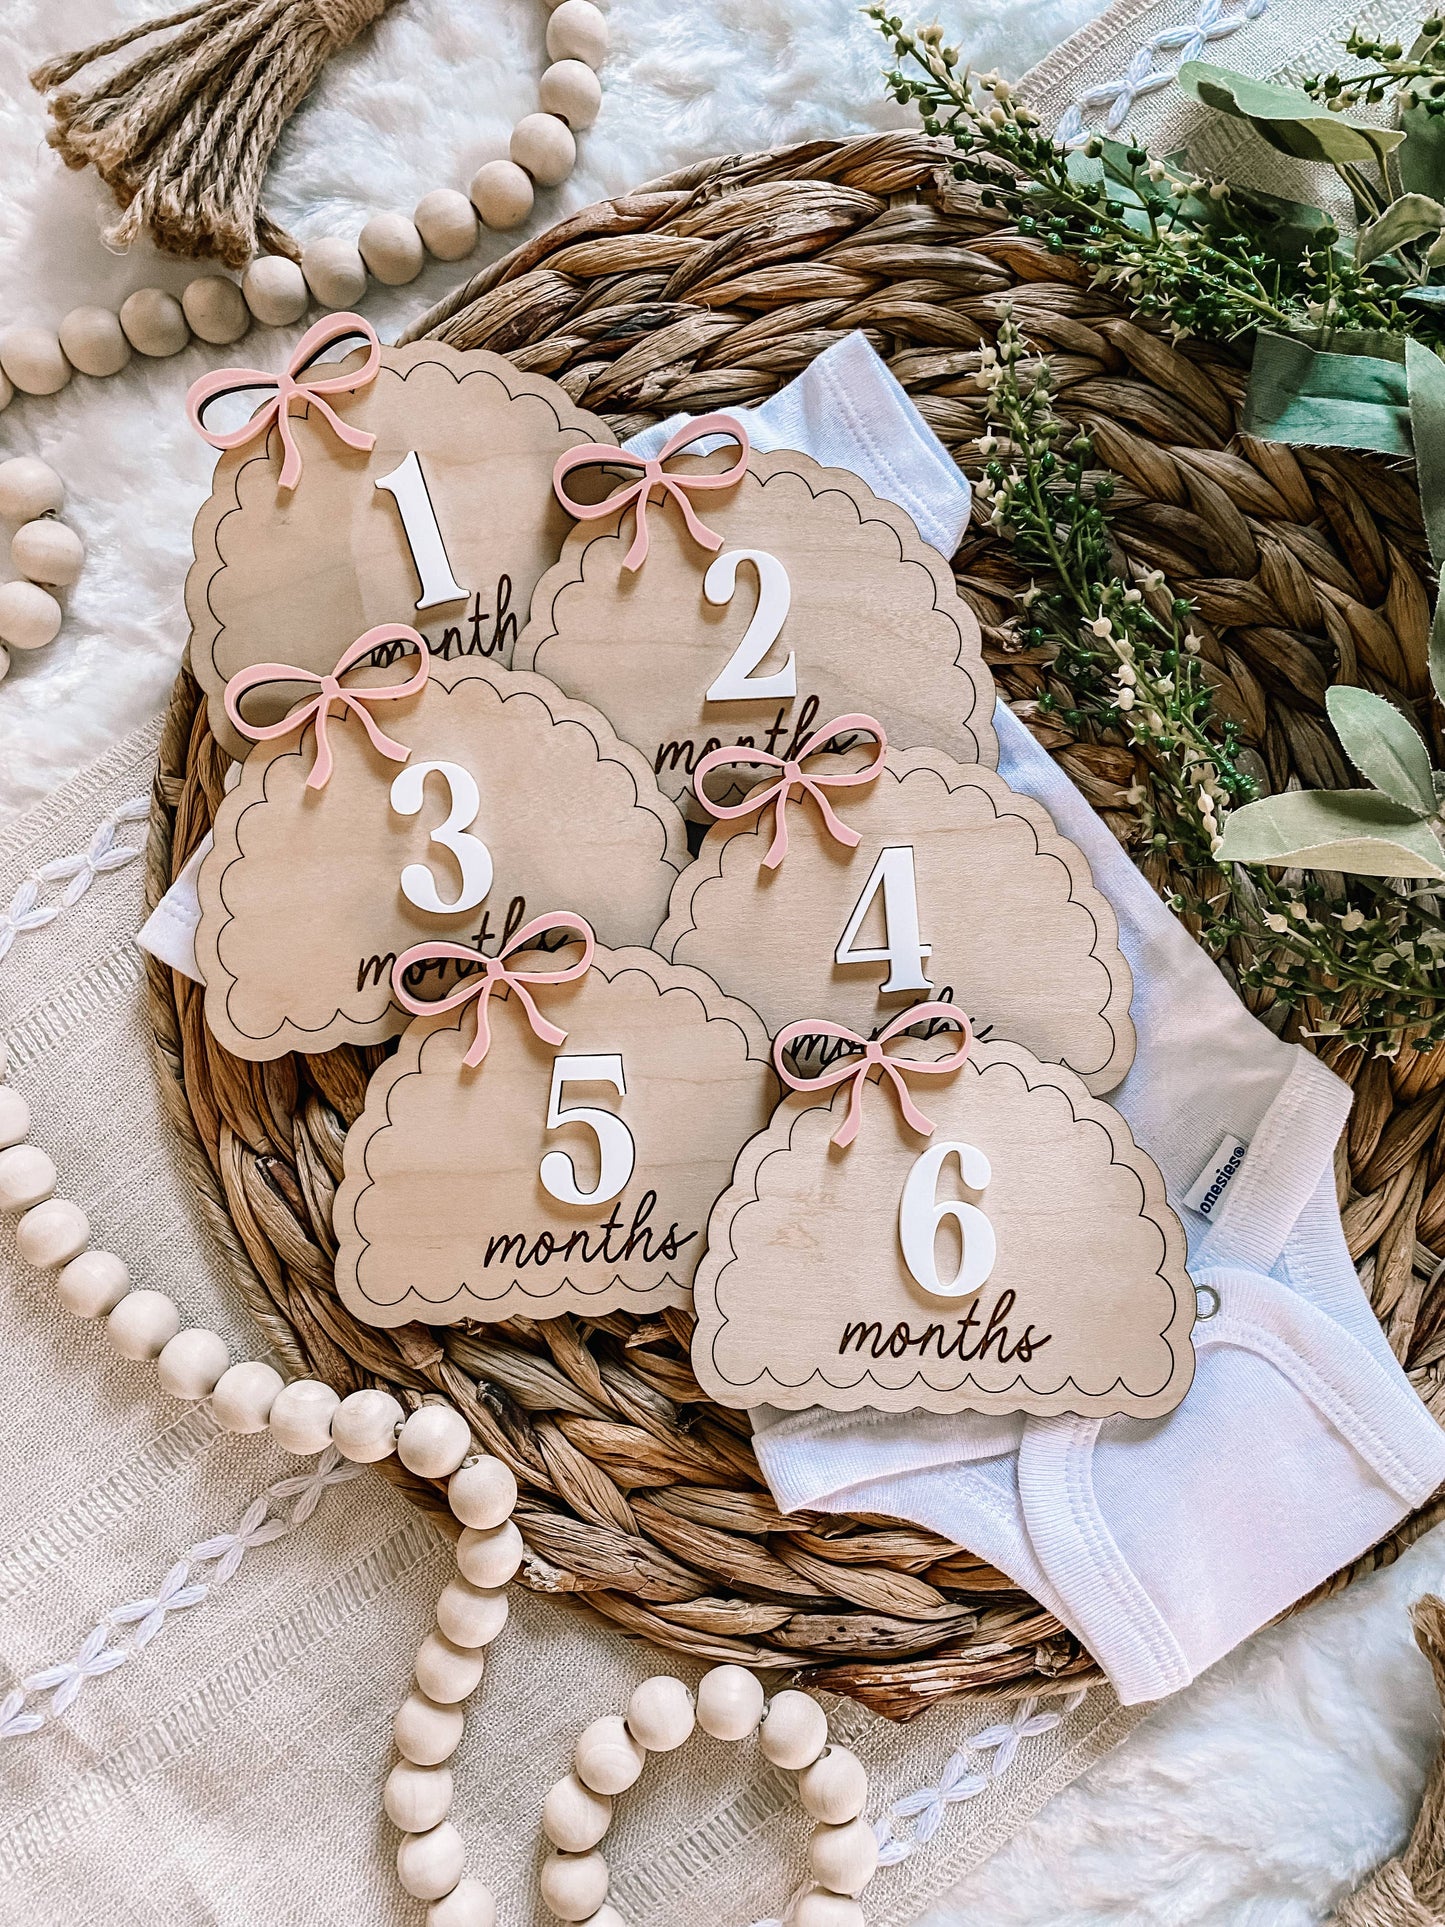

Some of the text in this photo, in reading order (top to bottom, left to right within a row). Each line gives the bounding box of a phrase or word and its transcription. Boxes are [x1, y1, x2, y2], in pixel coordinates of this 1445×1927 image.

[374, 451, 471, 610] 1
[703, 549, 796, 701] 2
[390, 760, 493, 914] 3
[835, 845, 934, 993] 4
[539, 1053, 635, 1205] 5
[483, 1190, 699, 1268] months
[898, 1141, 997, 1297] 6
[838, 1289, 1052, 1363] months
